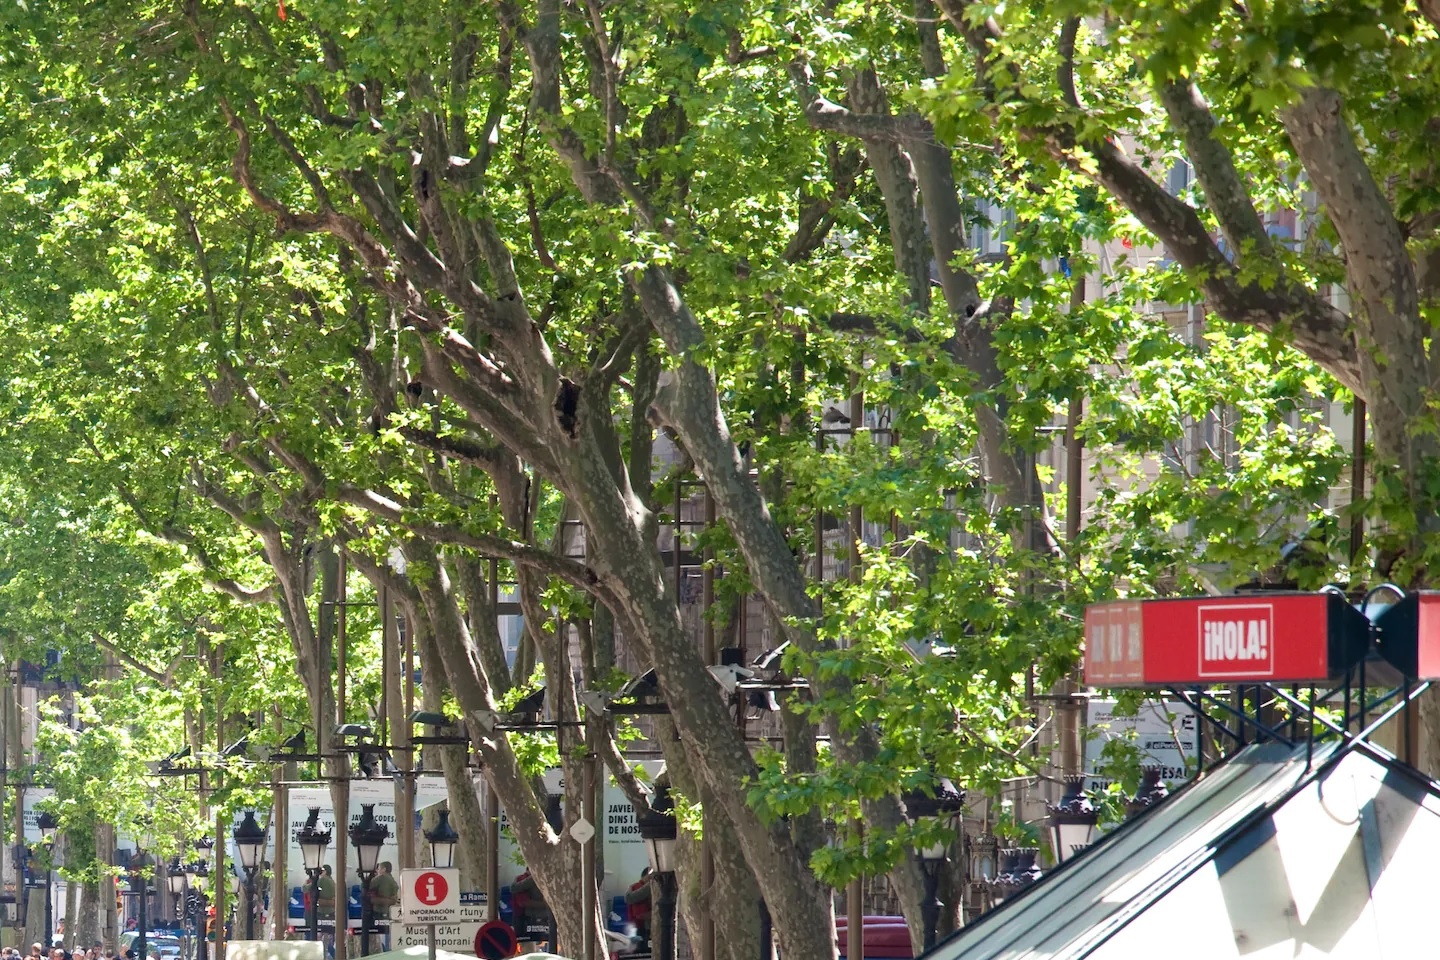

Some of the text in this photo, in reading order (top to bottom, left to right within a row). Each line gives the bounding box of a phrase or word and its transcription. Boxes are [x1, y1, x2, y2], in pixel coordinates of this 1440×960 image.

[1204, 619, 1267, 660] ¡HOLA!
[608, 805, 634, 813] JAVIE
[608, 815, 628, 823] DINS
[609, 826, 619, 834] DE
[460, 908, 484, 917] rtuny
[406, 927, 461, 935] Muse d'Art
[406, 937, 471, 947] Contmporani
